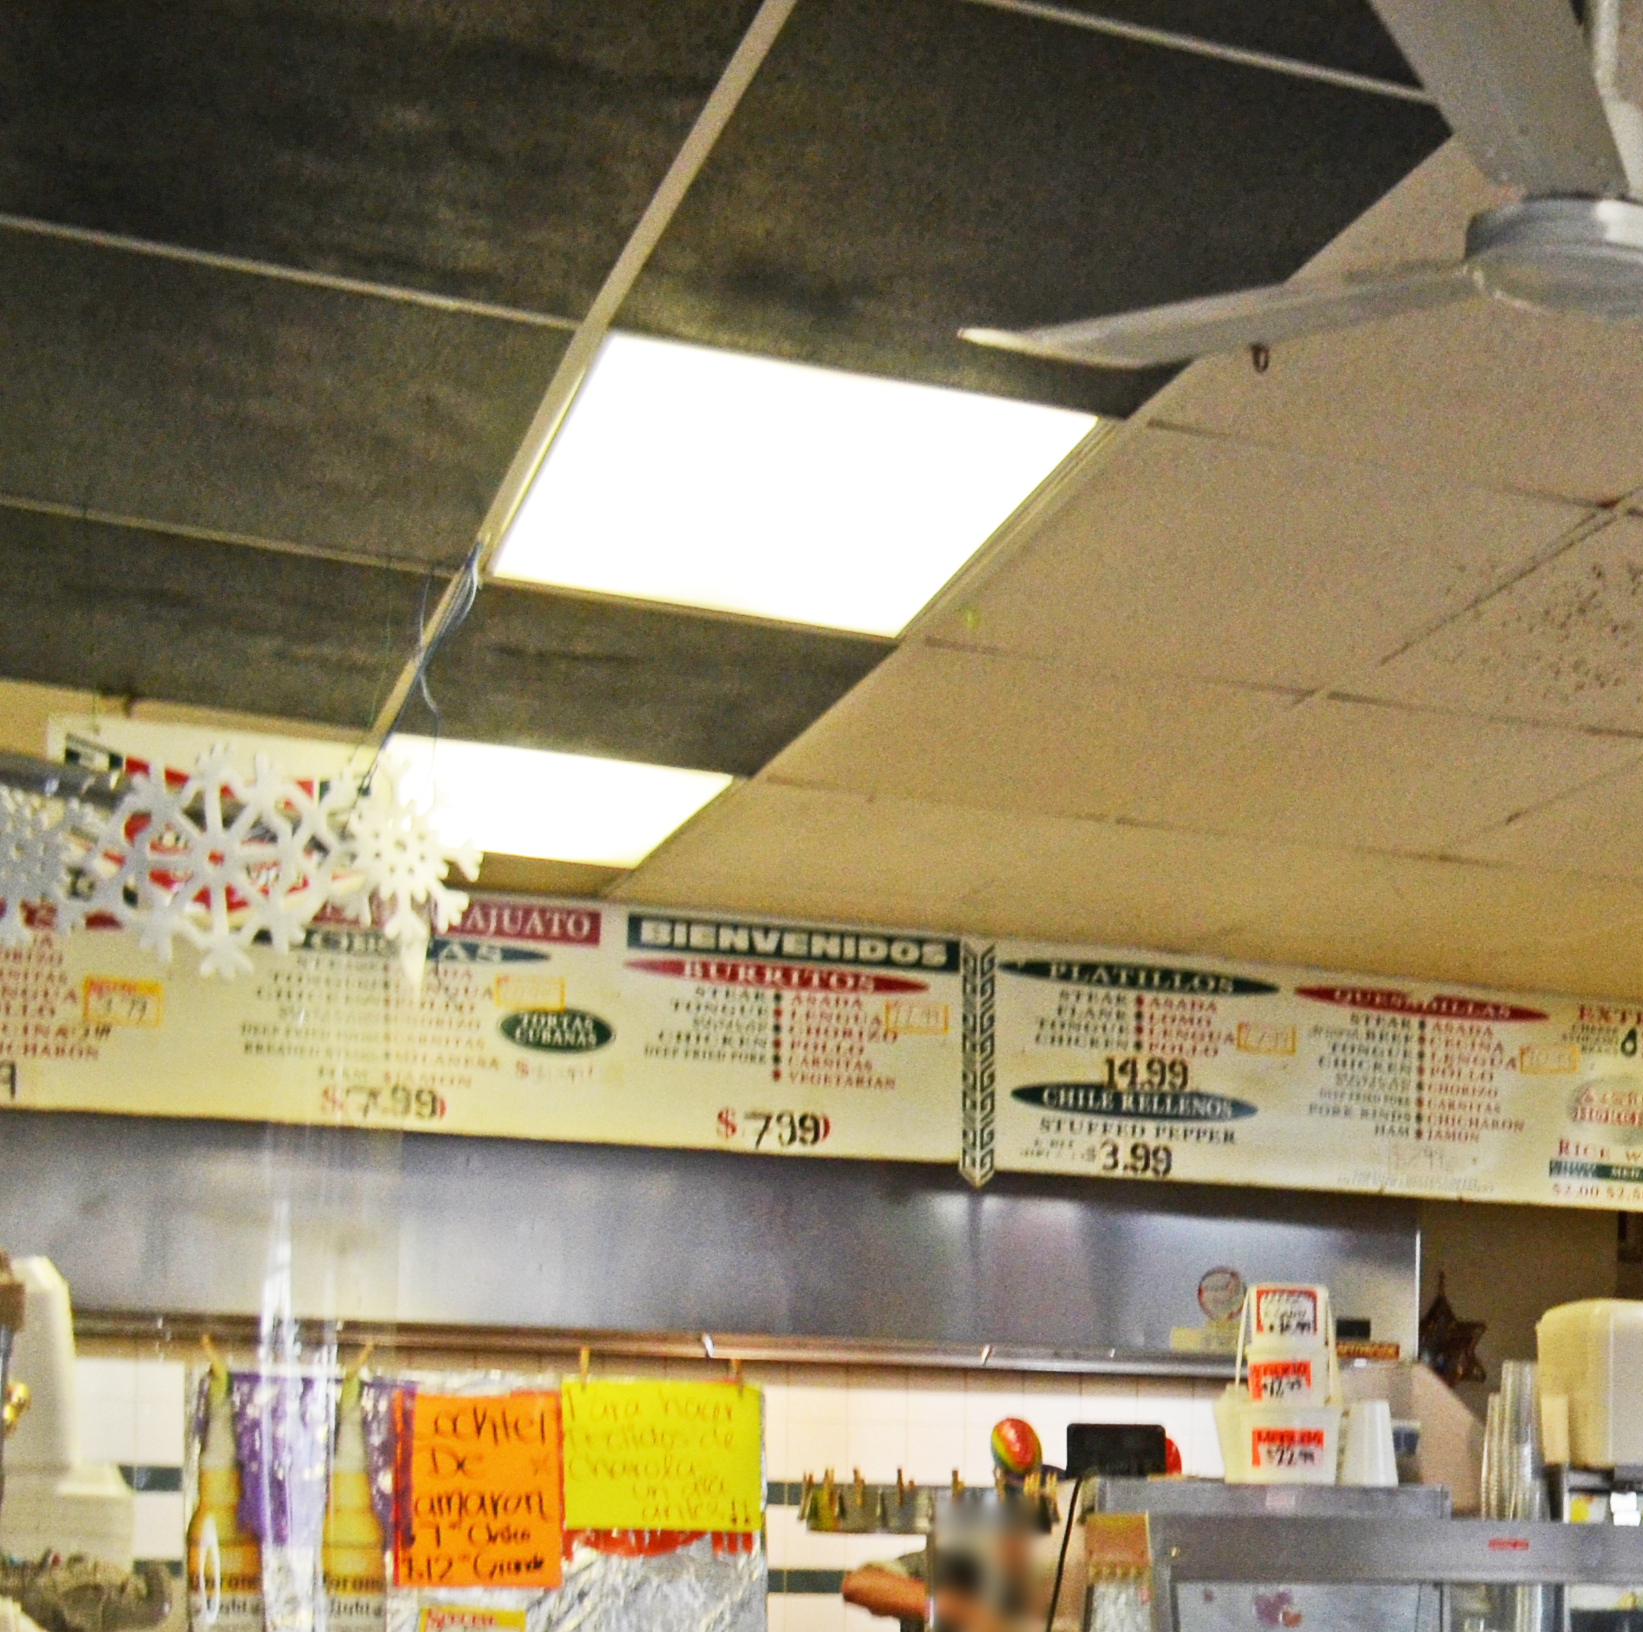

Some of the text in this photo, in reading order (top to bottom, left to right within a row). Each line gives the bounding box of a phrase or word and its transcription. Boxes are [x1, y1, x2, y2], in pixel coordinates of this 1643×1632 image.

[640, 920, 948, 967] BIENVENIDOS
[685, 959, 875, 992] BURRITOS
[1050, 963, 1234, 993] PLATILLOS
[1043, 1089, 1233, 1119] CHILE RELLENOS
[1040, 1117, 1237, 1145] STUFFED PEPPER
